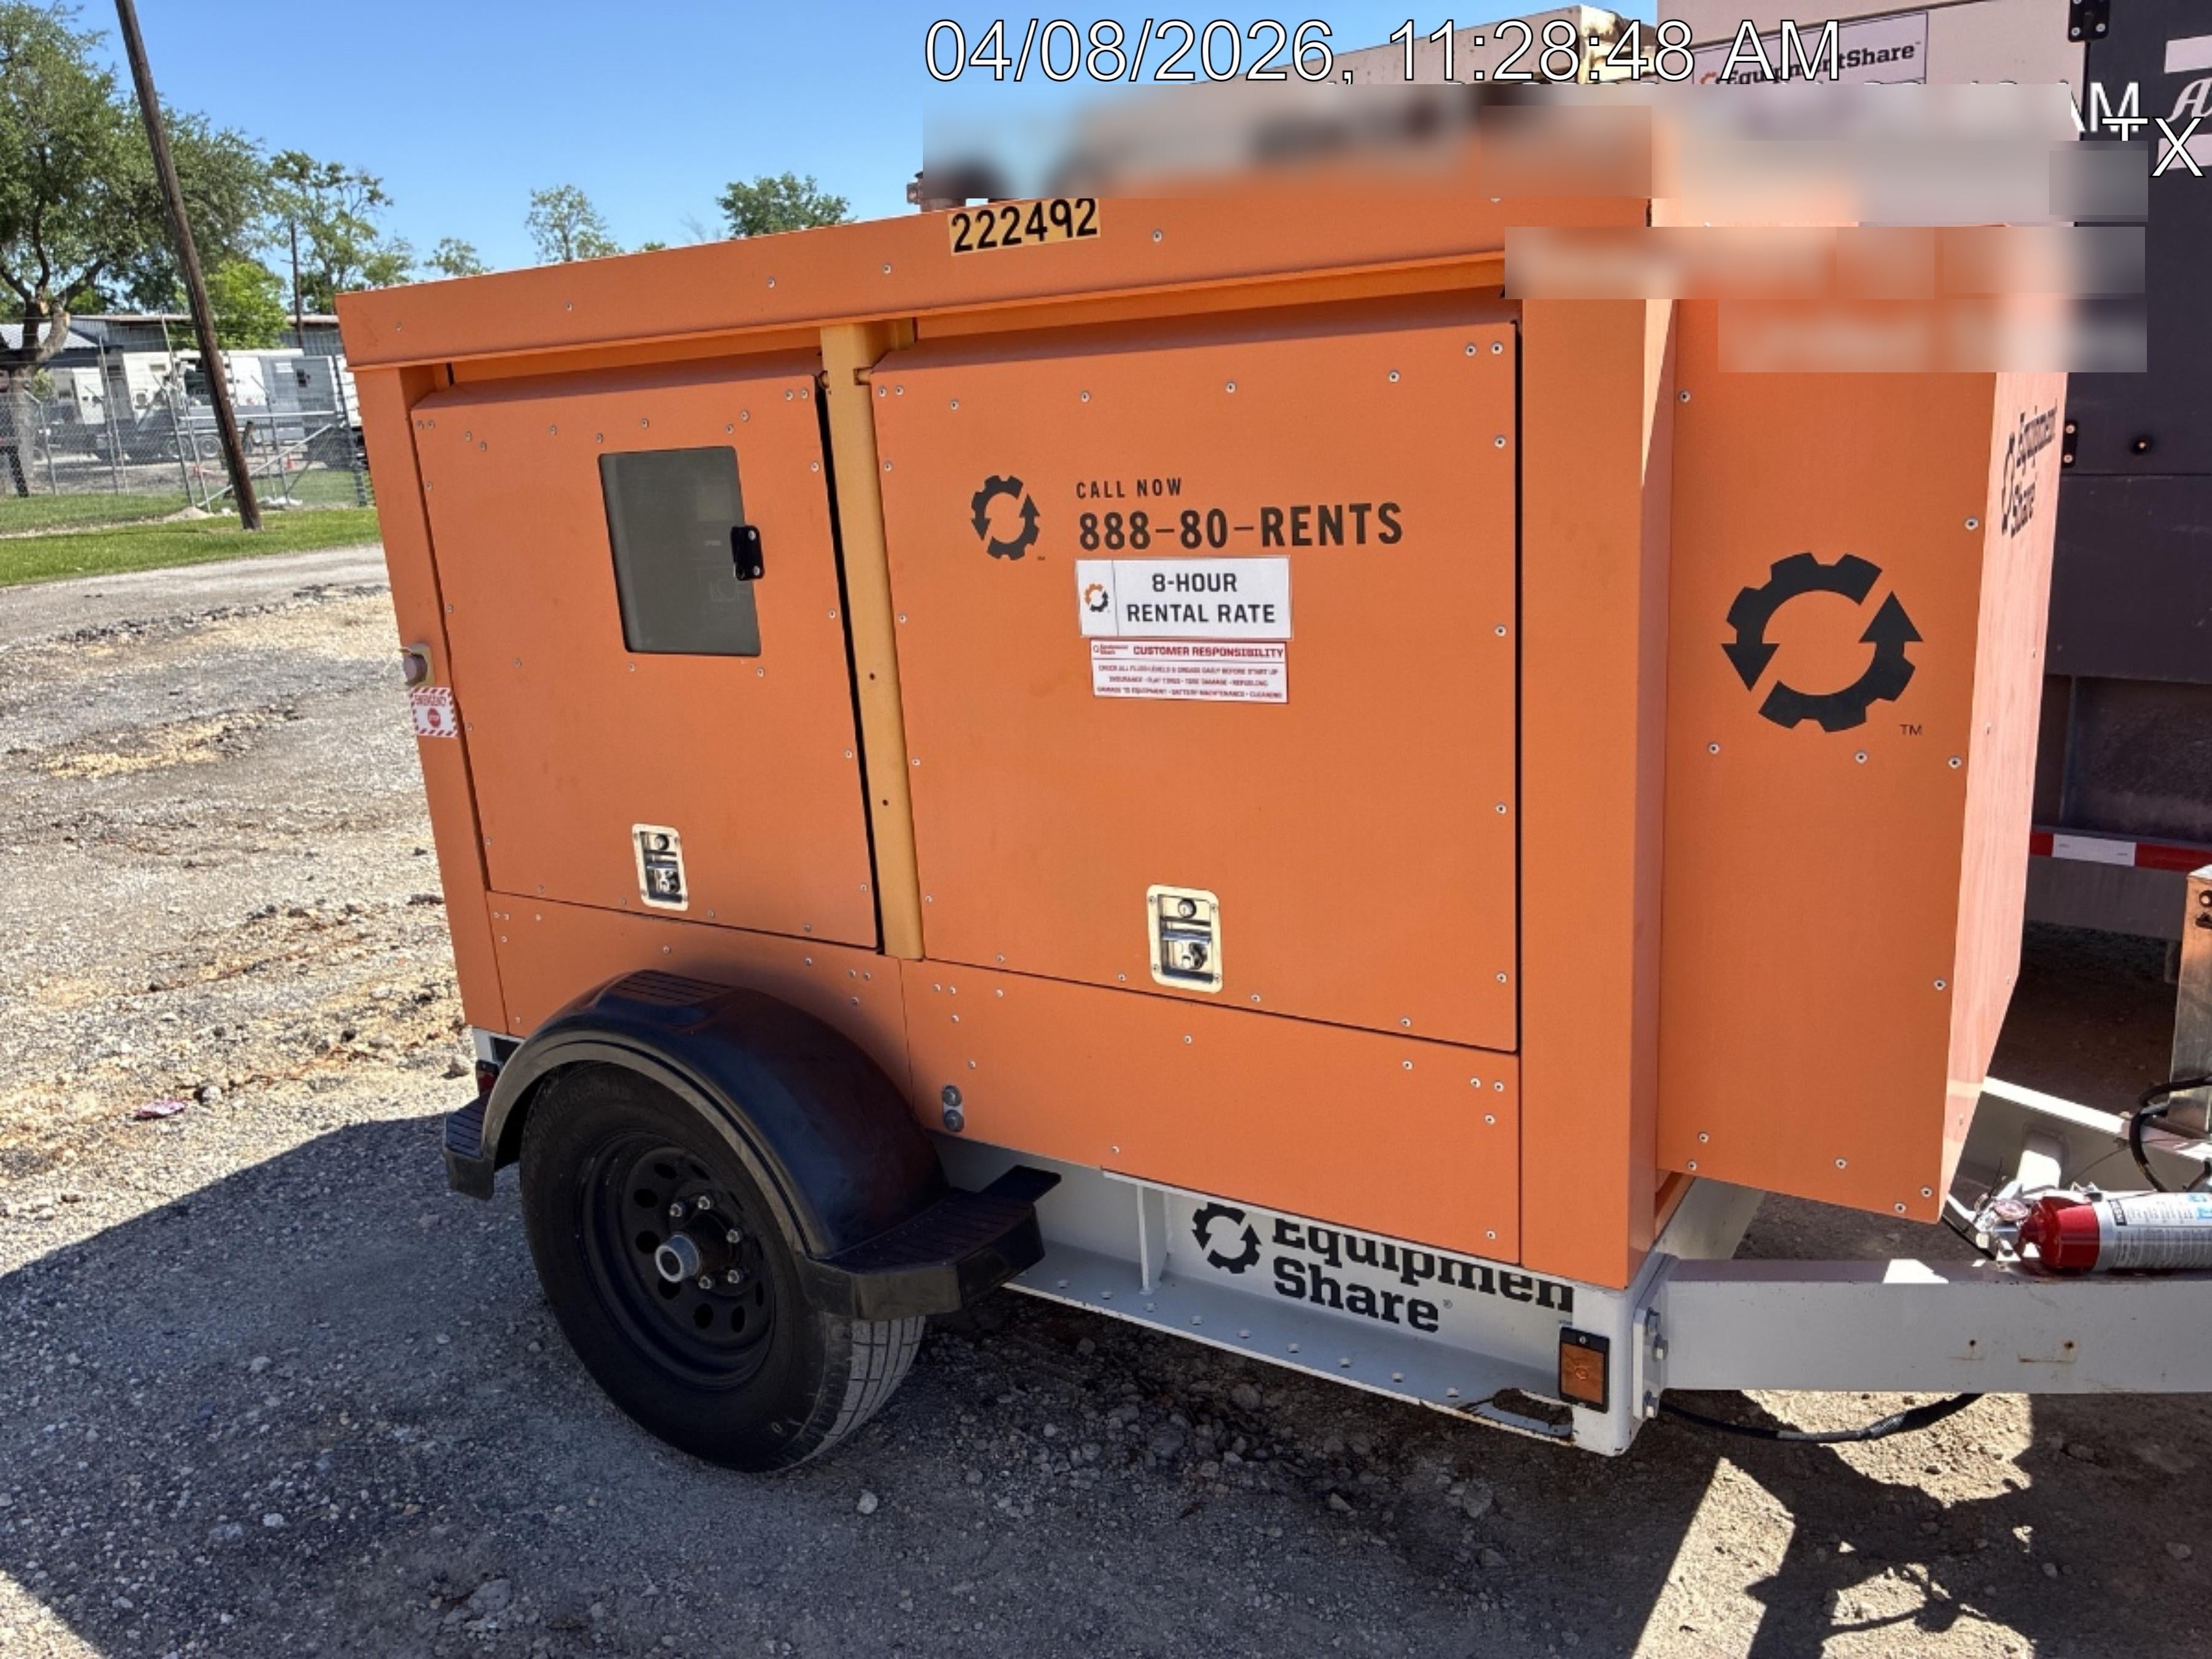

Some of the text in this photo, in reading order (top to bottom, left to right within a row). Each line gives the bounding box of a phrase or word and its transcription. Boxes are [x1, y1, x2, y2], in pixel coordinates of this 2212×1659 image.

[951, 198, 1098, 253] 222492
[1077, 477, 1182, 498] CALL NOW
[1080, 501, 1403, 551] 888-80-RENTS
[1151, 573, 1237, 592] 8-HOUR
[1127, 604, 1276, 623] RENTAL RATE
[1133, 646, 1190, 656] CUSTOMER
[1192, 647, 1284, 657] RESPONSIBILITY
[1272, 1218, 1574, 1313] Equipmen
[1273, 1255, 1439, 1333] Share
